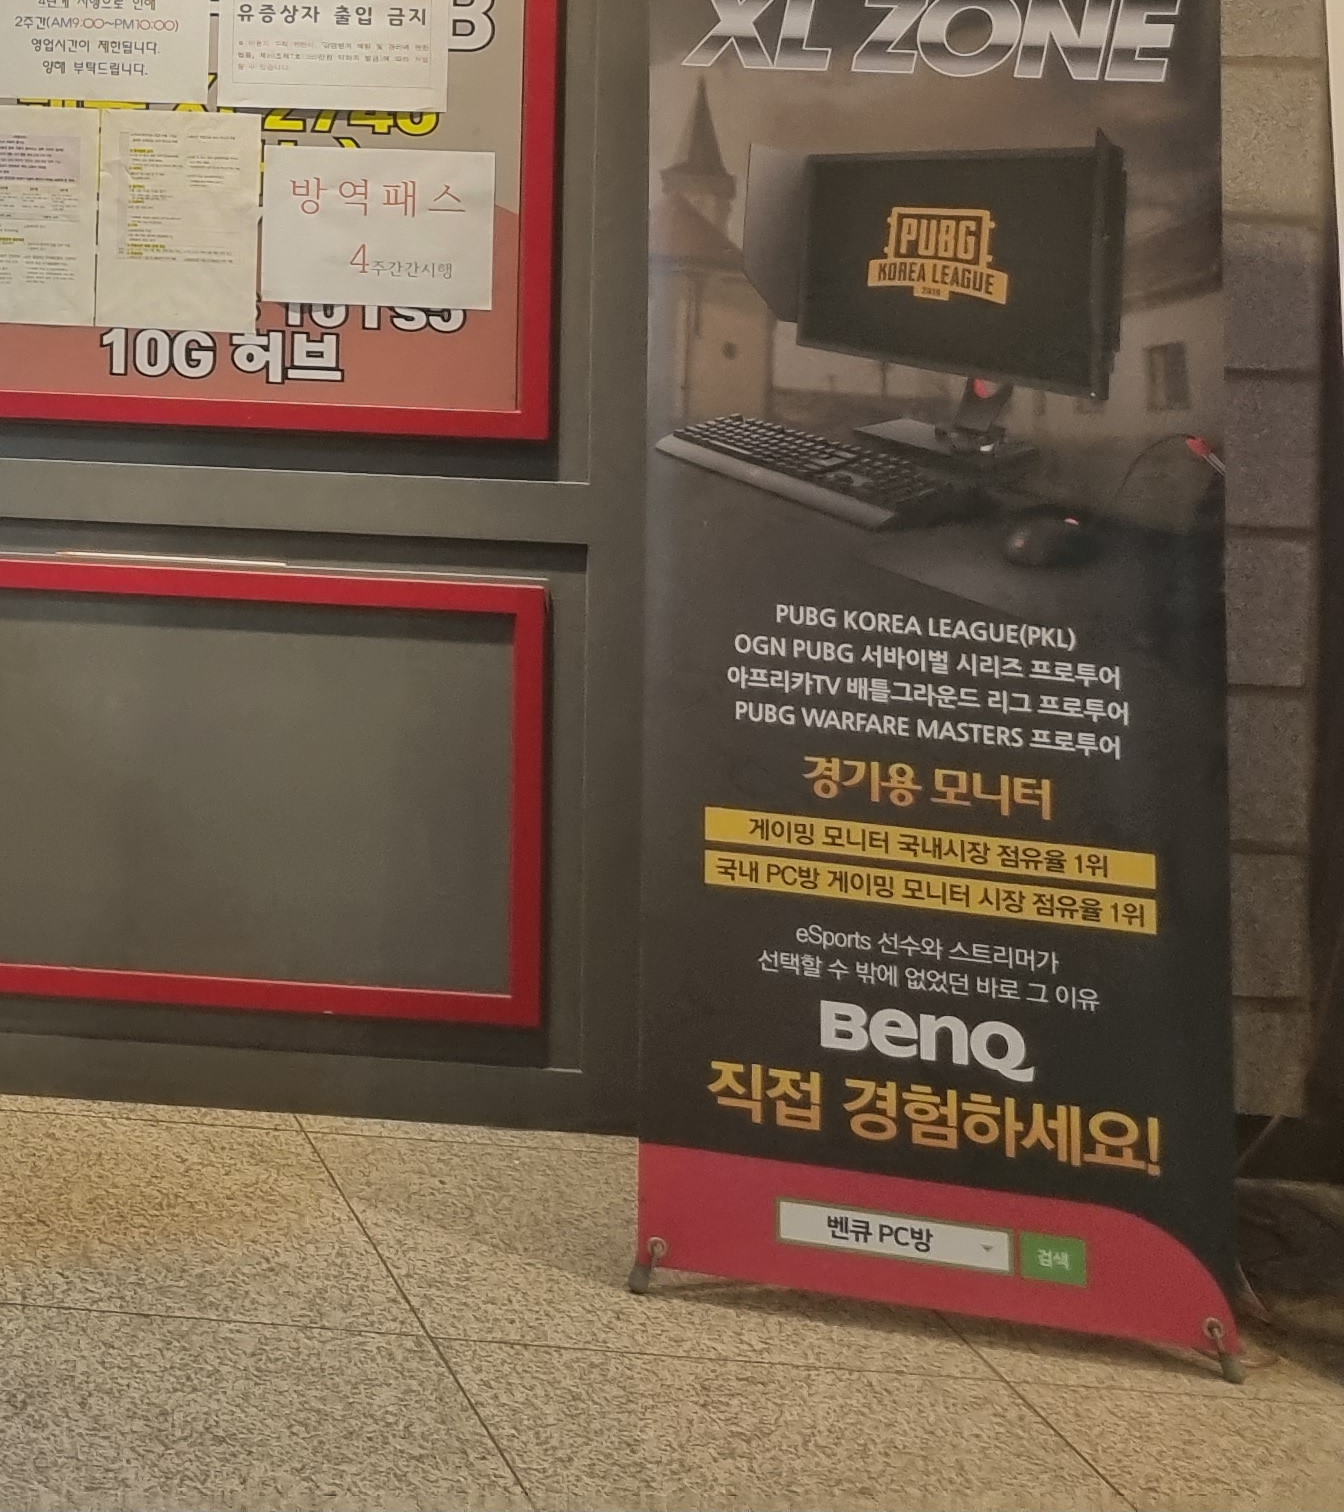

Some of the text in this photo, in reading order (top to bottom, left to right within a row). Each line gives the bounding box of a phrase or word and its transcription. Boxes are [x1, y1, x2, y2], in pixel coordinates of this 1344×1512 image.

[236, 3, 427, 27] 유증상자 출입 금지
[30, 38, 90, 53] 영업시간이
[42, 60, 149, 76] 양해 부탁드립니다.
[899, 217, 977, 261] PUBG
[877, 261, 995, 296] KOREA LEAGUE
[100, 326, 345, 384] 10G 허브
[776, 603, 1077, 652] PUBG KOREA LEAGUE(PKL)
[734, 633, 1122, 691] OGN PUBG 서바이벌 시리즈 프로투어
[726, 664, 1130, 727] 아프리카TV 배틀그라운드 리그 프로투어
[735, 700, 1122, 761] PUBG WARFARE MASTERS 프로투어
[802, 755, 1053, 821] 경기용 모니터
[748, 817, 1109, 879] 게이밍 모니터 국내시장 점유율 1위
[715, 857, 1146, 928] 국내 PC방 게이밍 모니터 시장 점유율 1위
[795, 924, 1060, 975] eSports 선수와 스트리머가
[758, 949, 1101, 1013] 선택할 수 밖에 없었던 바로 그 이유
[819, 999, 1035, 1083] BenQ
[706, 1059, 1161, 1178] 직접 경험하세요!
[826, 1213, 934, 1255] 벤큐 PC방
[1037, 1246, 1071, 1272] 검색
